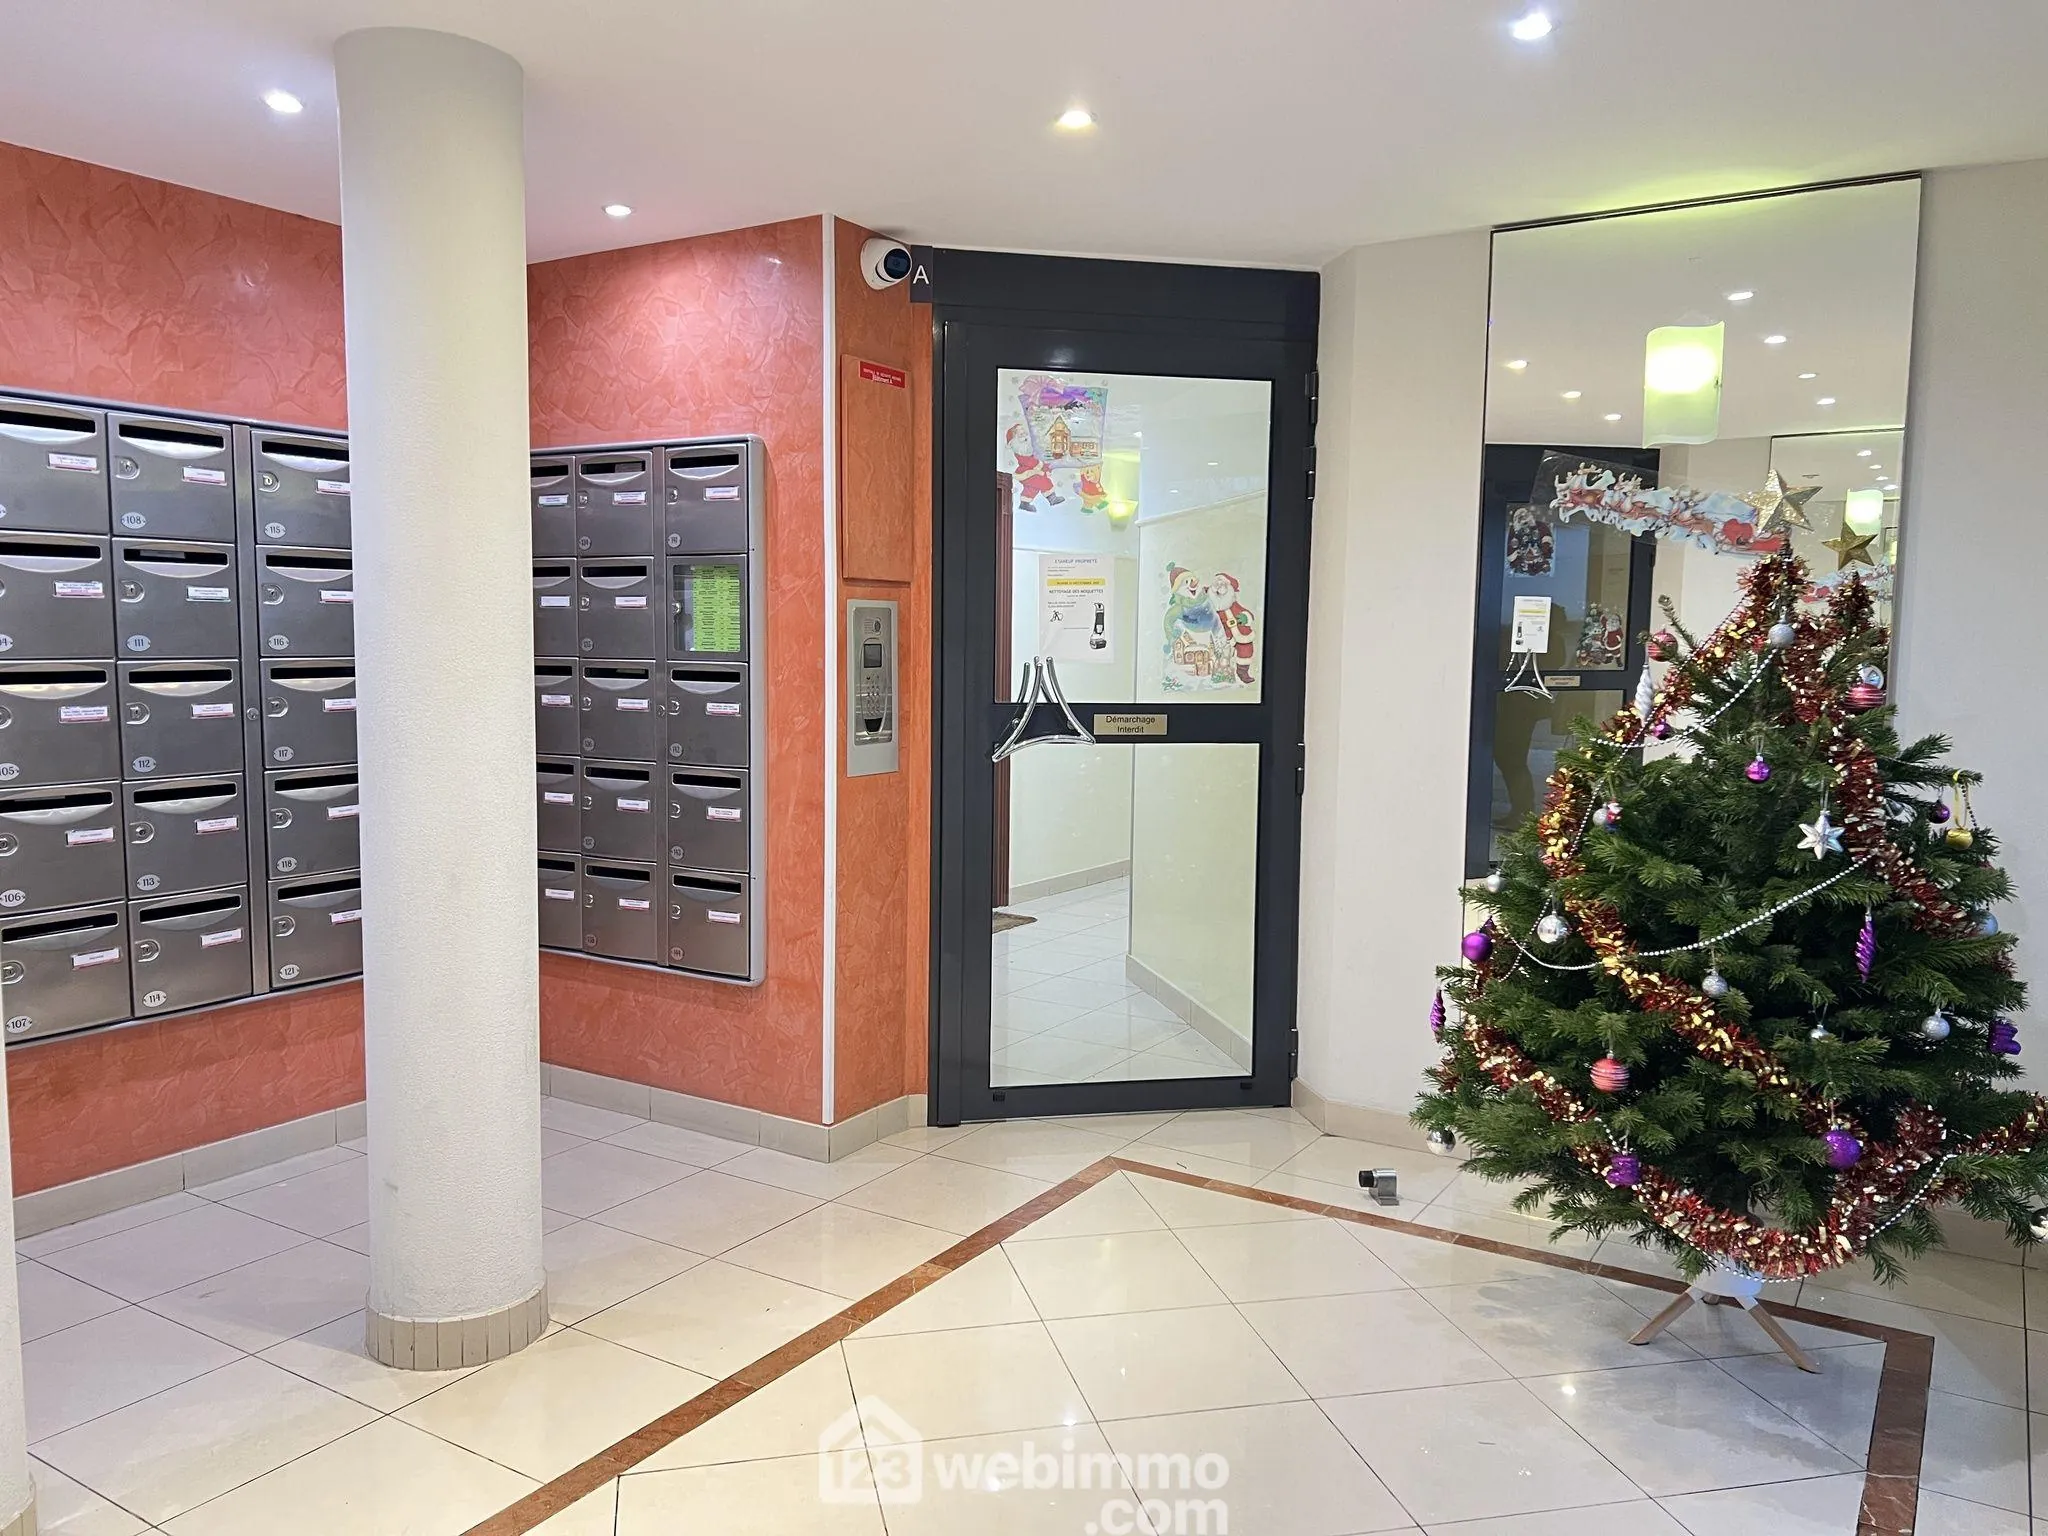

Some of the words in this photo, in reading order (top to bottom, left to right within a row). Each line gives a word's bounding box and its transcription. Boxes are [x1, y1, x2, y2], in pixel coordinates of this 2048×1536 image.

[913, 265, 929, 284] A
[126, 515, 141, 525] 108
[1105, 715, 1156, 725] Démarchage
[138, 759, 150, 768] 112
[142, 877, 155, 887] 113
[4, 891, 21, 903] 106
[11, 1018, 27, 1029] 107
